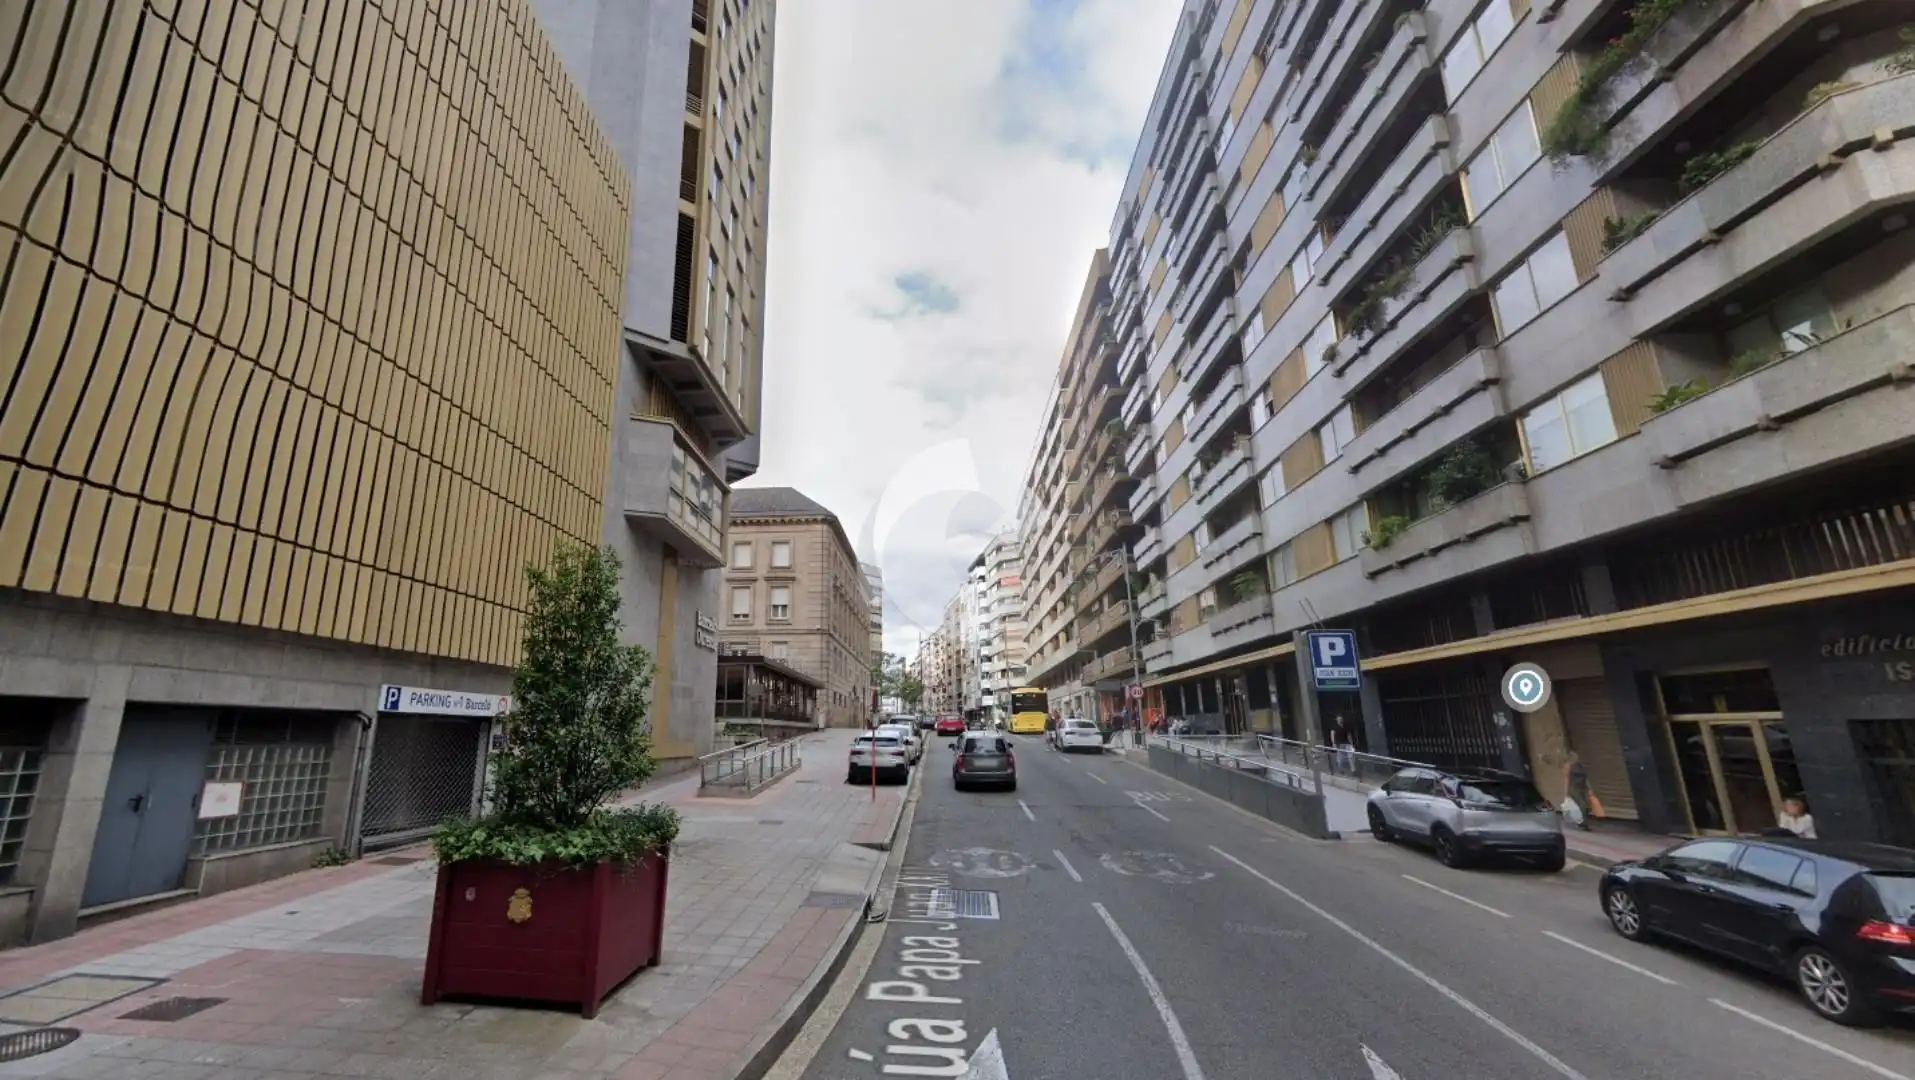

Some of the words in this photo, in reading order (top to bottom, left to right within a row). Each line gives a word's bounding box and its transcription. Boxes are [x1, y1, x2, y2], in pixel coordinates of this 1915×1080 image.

[1318, 636, 1345, 666] P
[387, 688, 399, 708] P
[410, 692, 451, 709] PARKING
